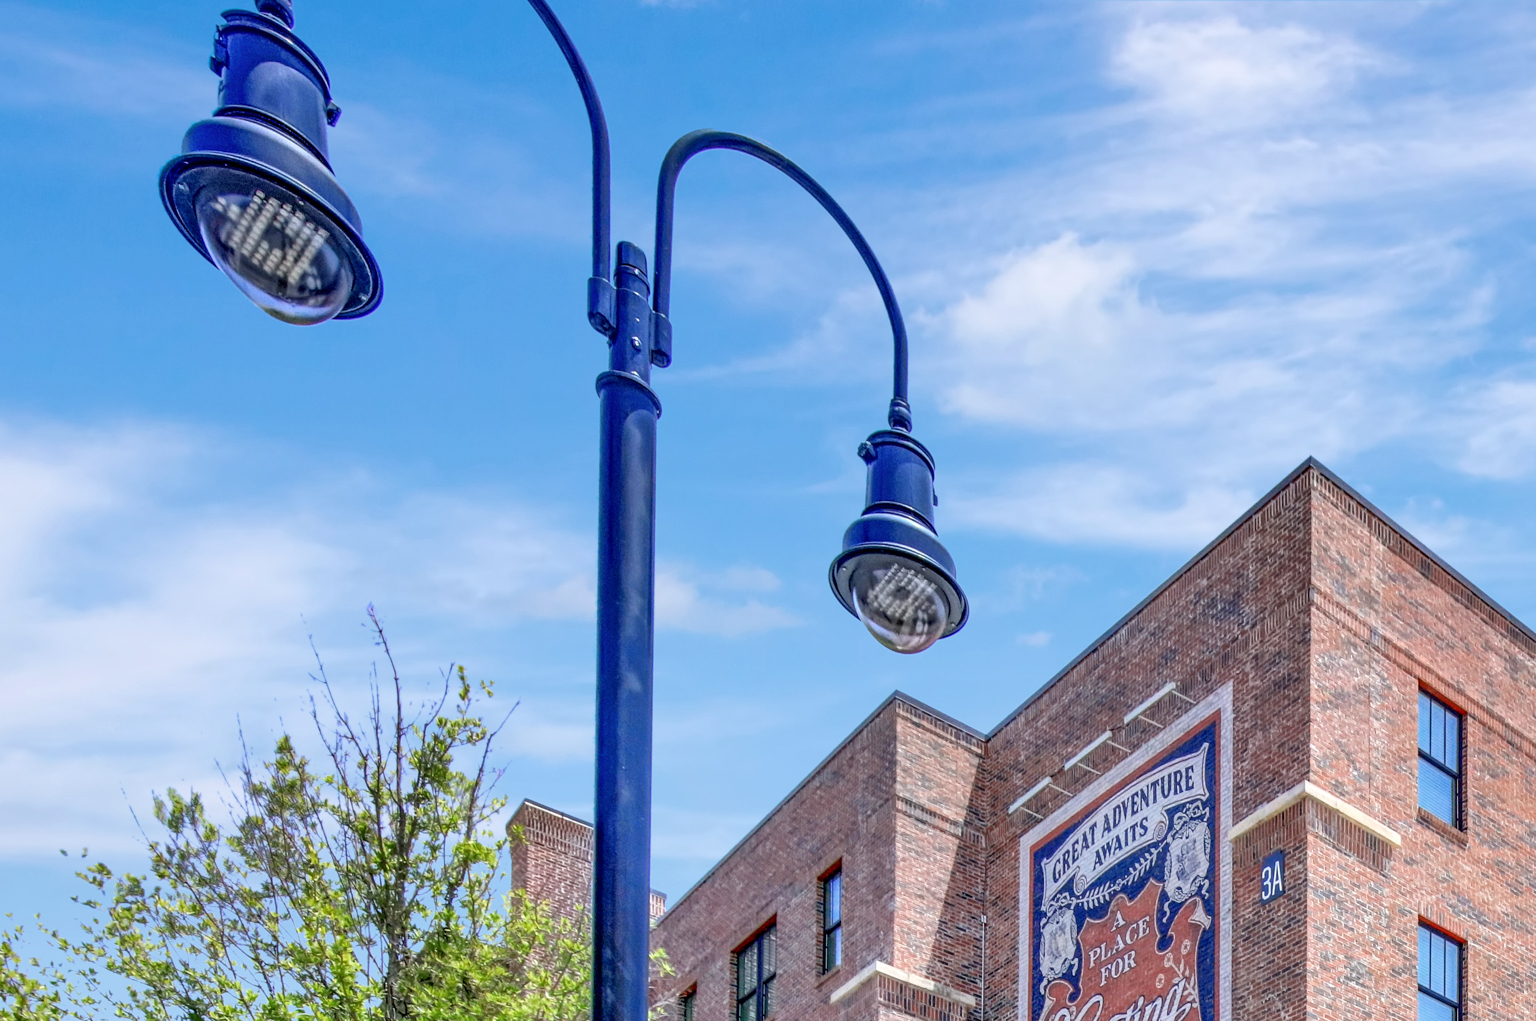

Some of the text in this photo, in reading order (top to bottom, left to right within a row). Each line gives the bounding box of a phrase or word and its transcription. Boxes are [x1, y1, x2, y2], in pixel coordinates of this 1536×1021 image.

[1052, 765, 1195, 883] GREAT ADVENTURE
[1092, 817, 1149, 872] AWAITS
[1262, 861, 1283, 901] 3A
[1088, 916, 1150, 970] PLACE
[1111, 910, 1126, 932] A
[1100, 950, 1137, 987] FOR
